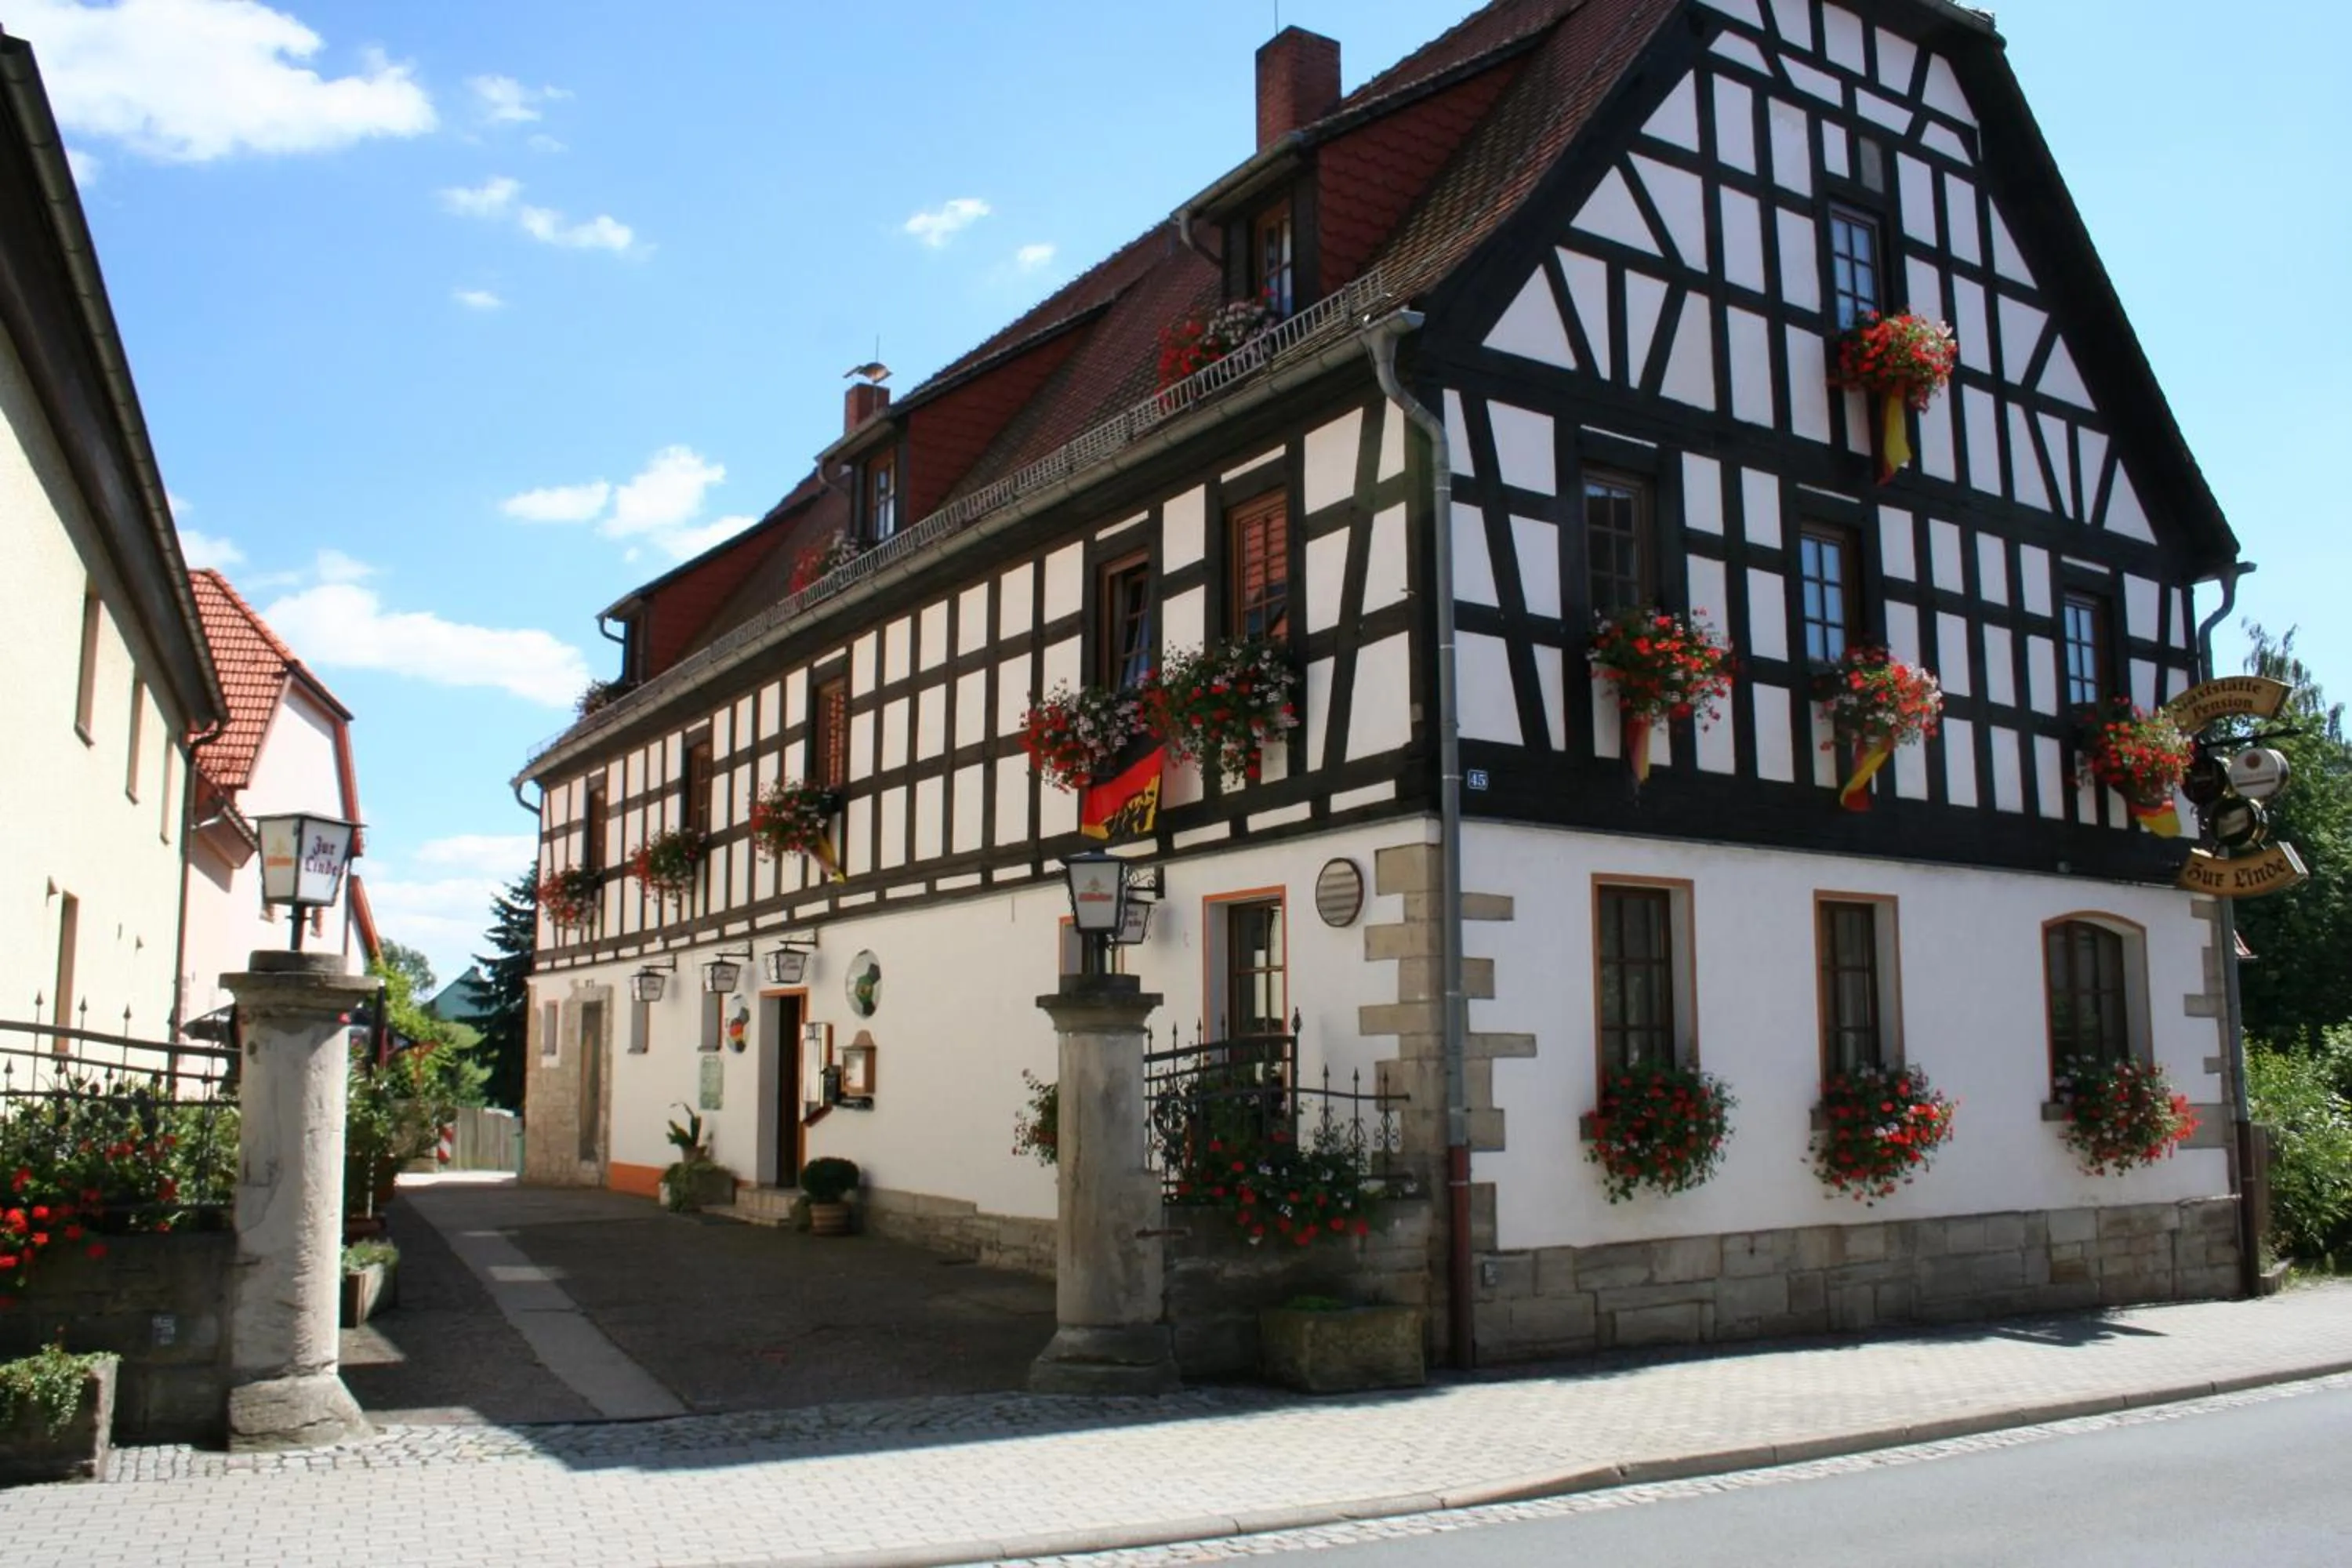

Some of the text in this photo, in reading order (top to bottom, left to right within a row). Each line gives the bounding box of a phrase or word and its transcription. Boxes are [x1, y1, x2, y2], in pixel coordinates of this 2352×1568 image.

[1470, 772, 1486, 786] 45
[312, 835, 336, 855] Zur
[305, 855, 338, 877] Linde
[2187, 858, 2286, 888] Zur Linde
